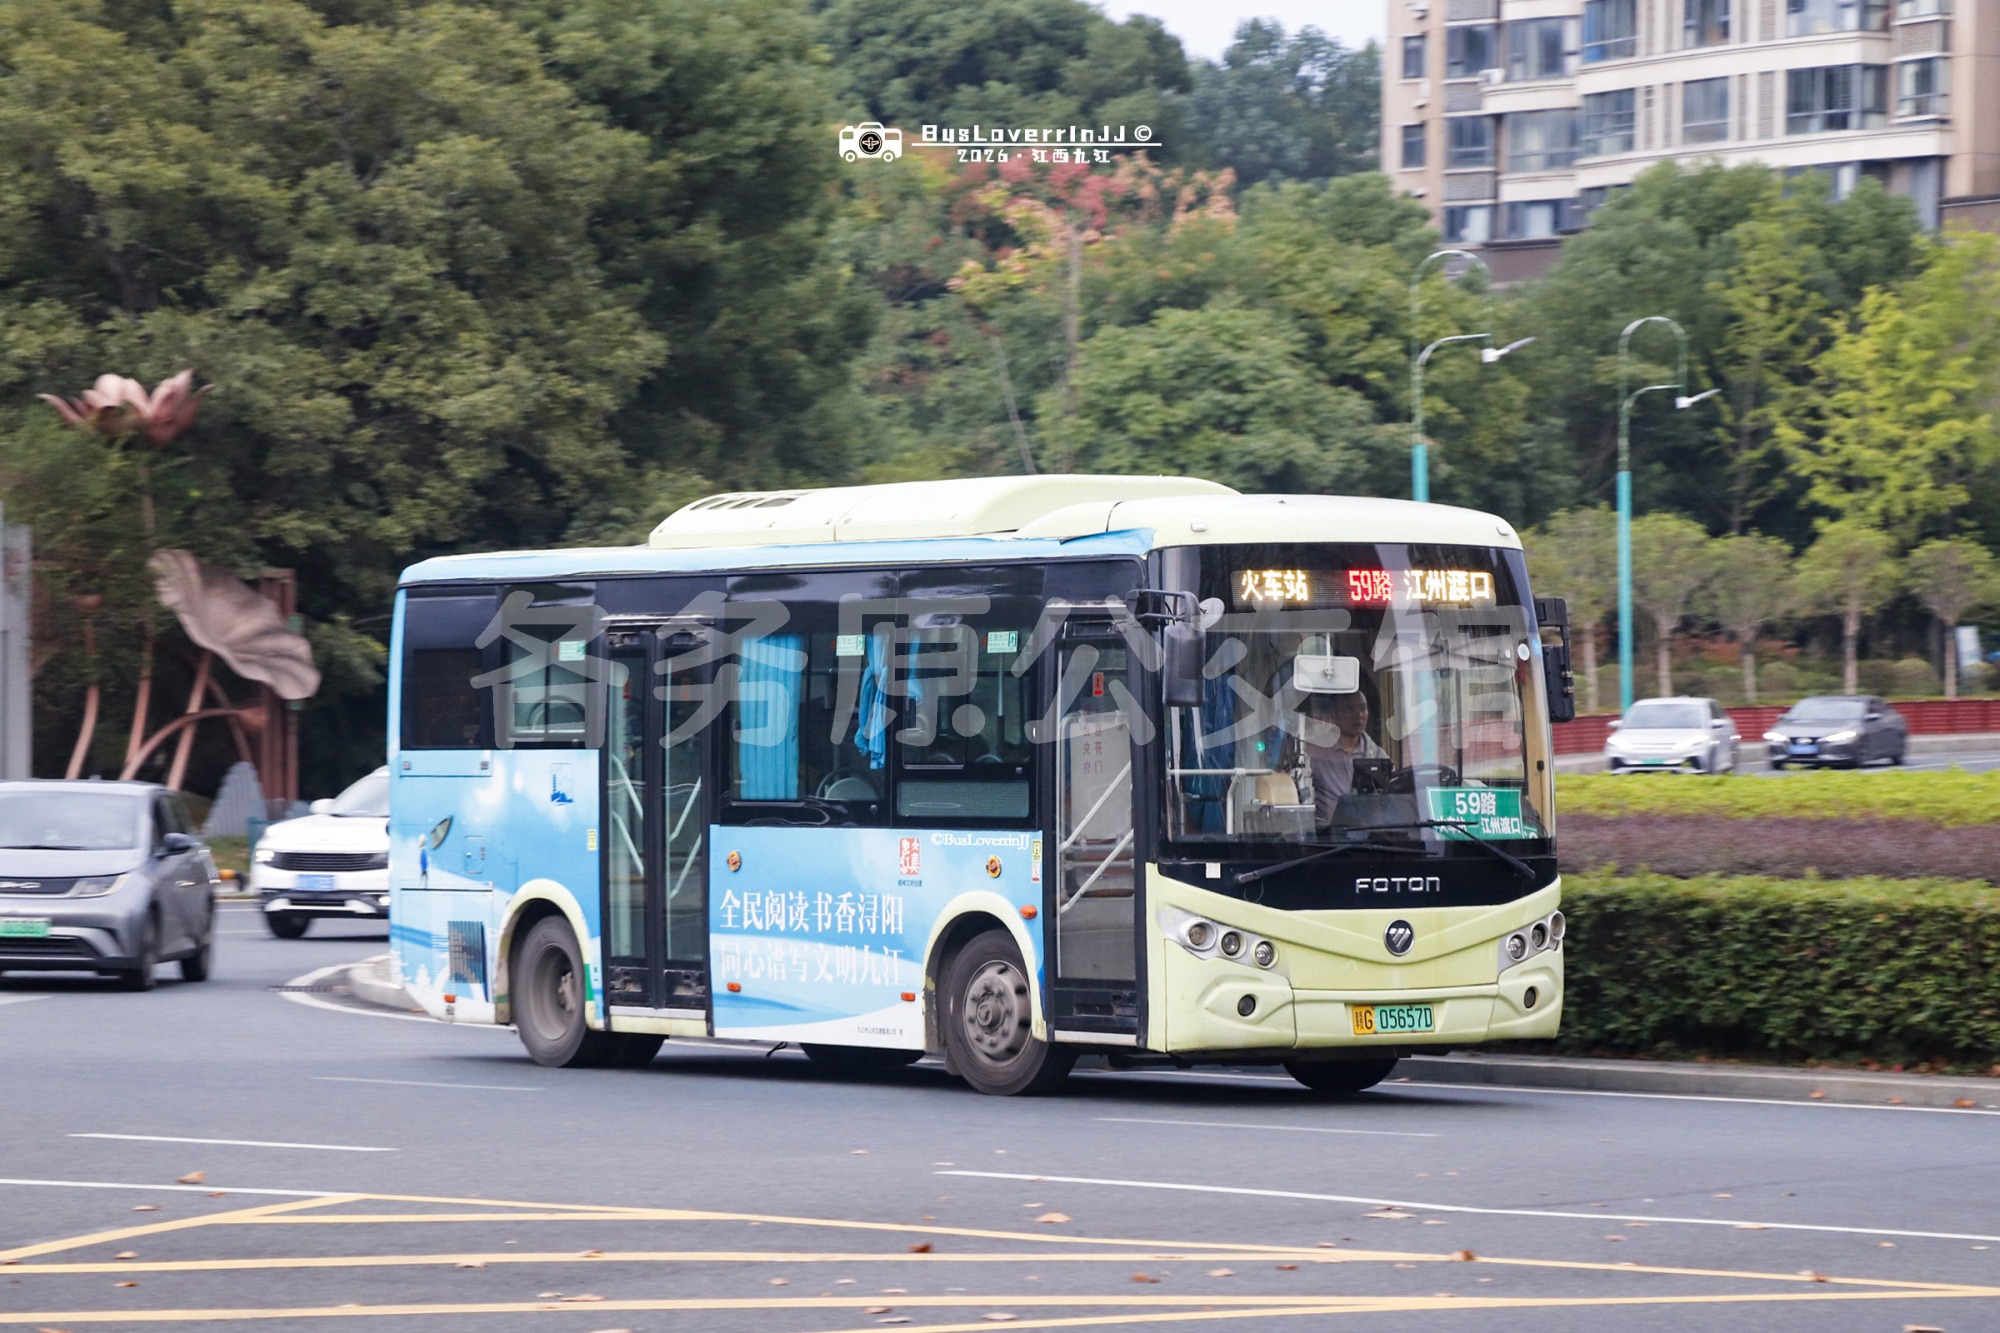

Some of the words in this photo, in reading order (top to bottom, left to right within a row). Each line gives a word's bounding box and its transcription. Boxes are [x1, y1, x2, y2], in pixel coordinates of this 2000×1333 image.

[1241, 569, 1309, 602] 火车站
[1349, 569, 1393, 602] 59路
[1403, 569, 1491, 602] 江州渡口
[1455, 792, 1497, 815] 59路
[1355, 876, 1441, 894] FOTON
[719, 889, 904, 935] 全民阅读书香浔阳
[720, 941, 905, 988] 同心谱写文明九江
